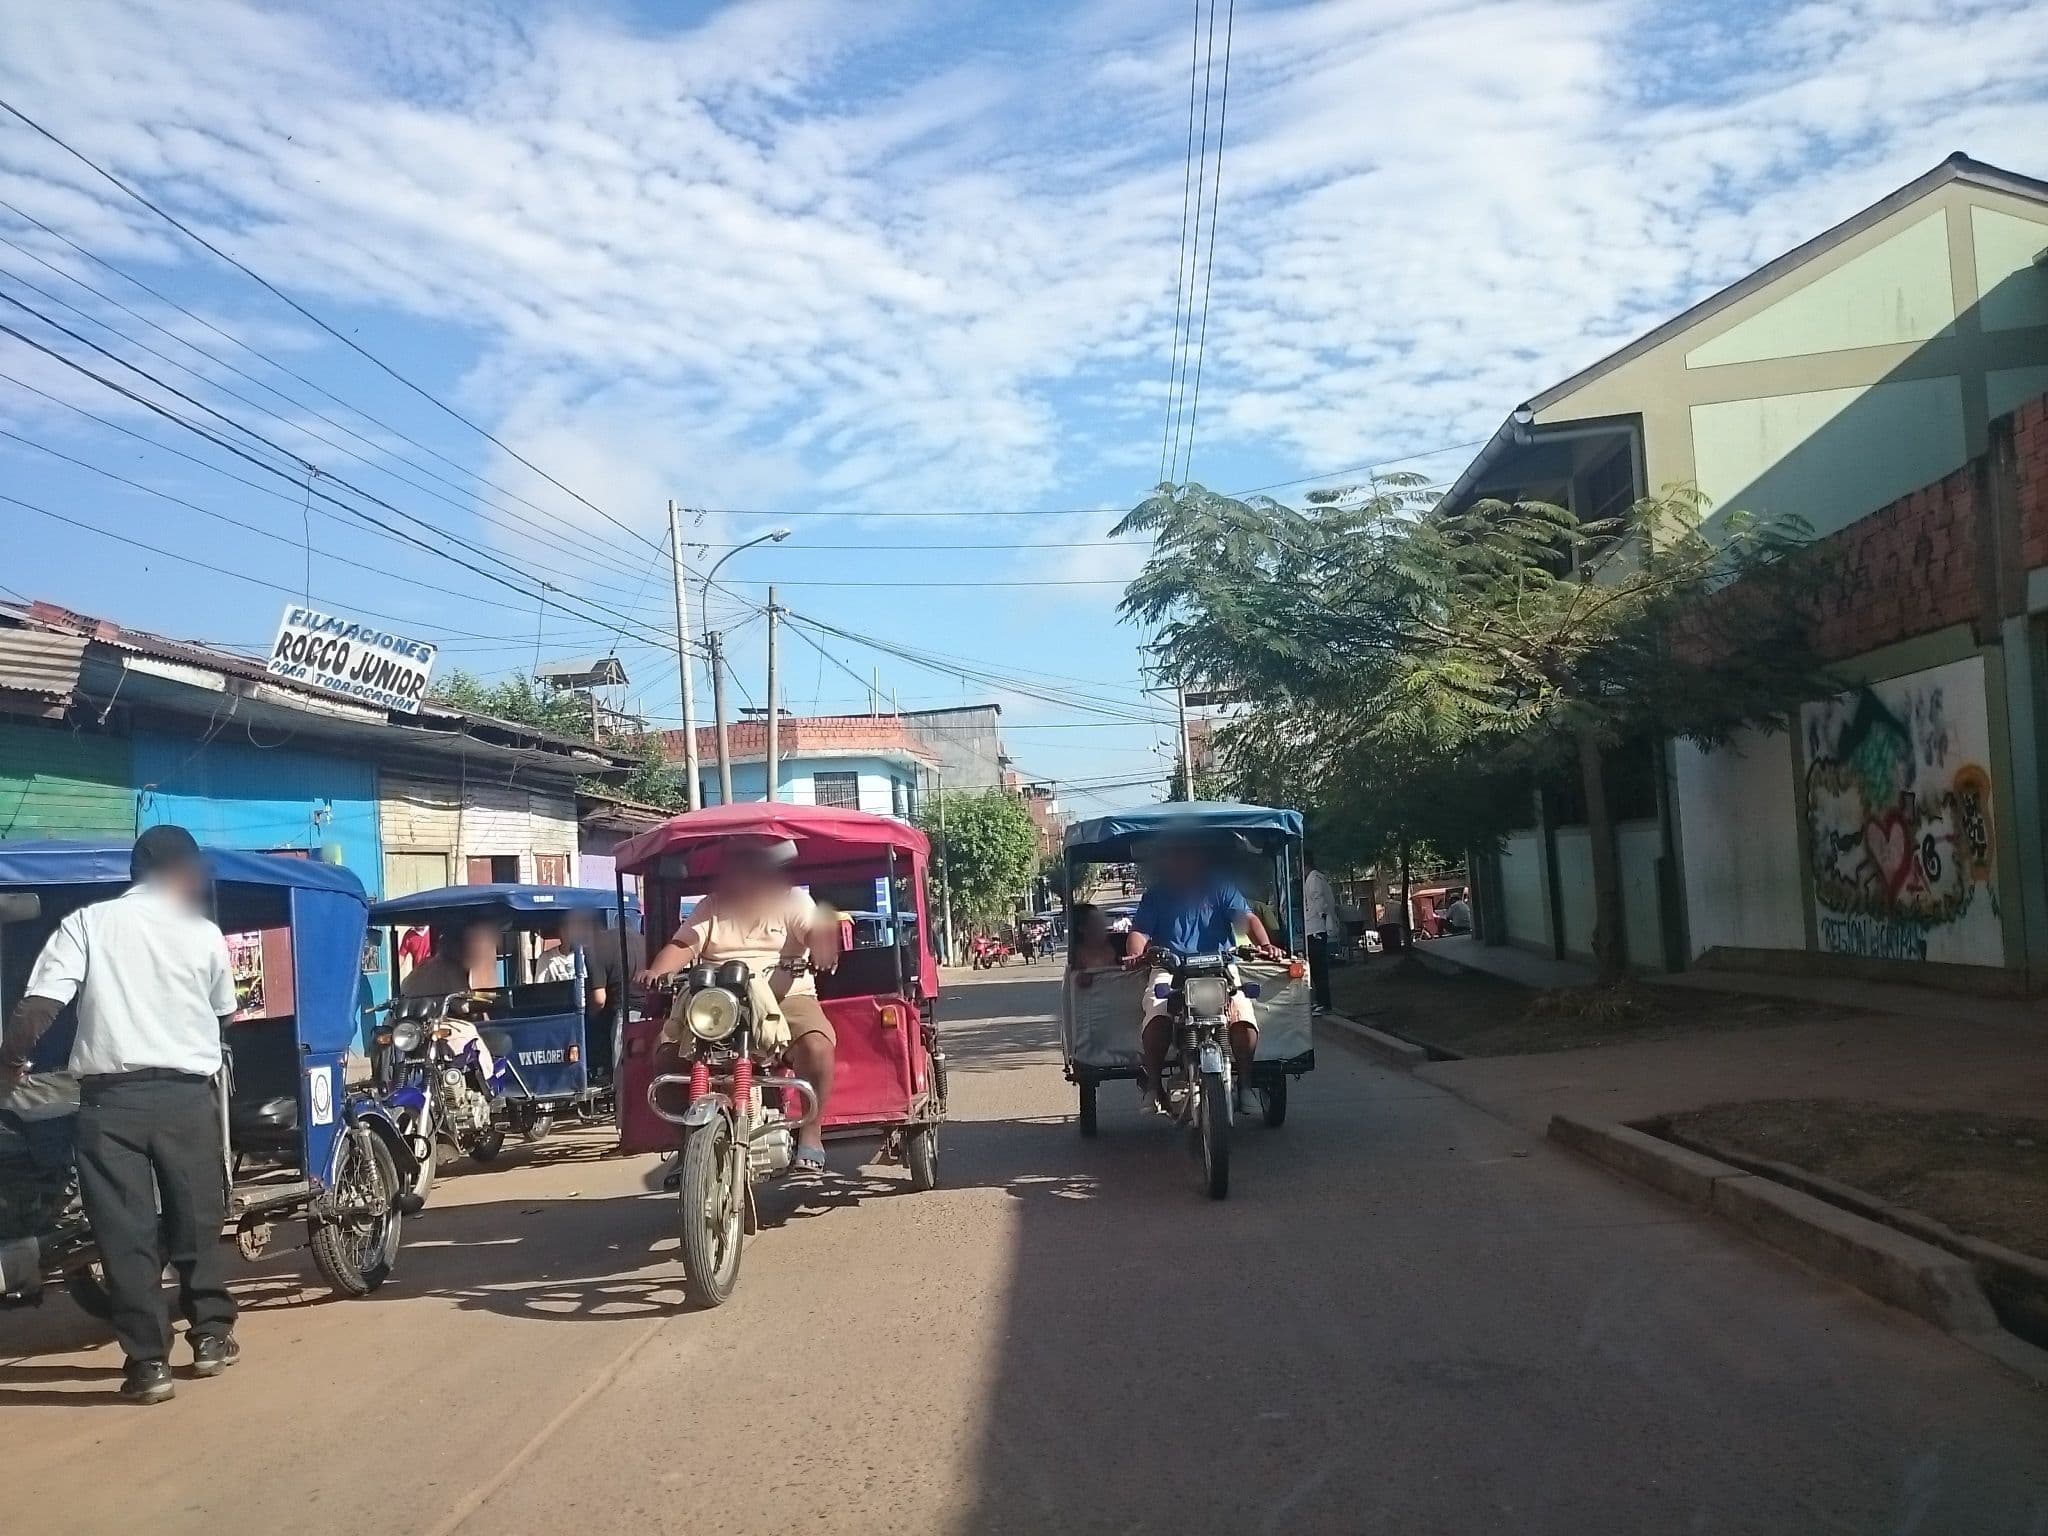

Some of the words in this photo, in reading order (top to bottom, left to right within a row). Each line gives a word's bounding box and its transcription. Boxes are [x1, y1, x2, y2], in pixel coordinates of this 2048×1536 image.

[289, 609, 431, 664] FILMACIONES
[270, 660, 307, 679] PARA
[315, 673, 351, 692] TODA
[352, 685, 416, 711] OCACION
[275, 631, 350, 675] ROCCO
[350, 652, 425, 700] JUNIOR
